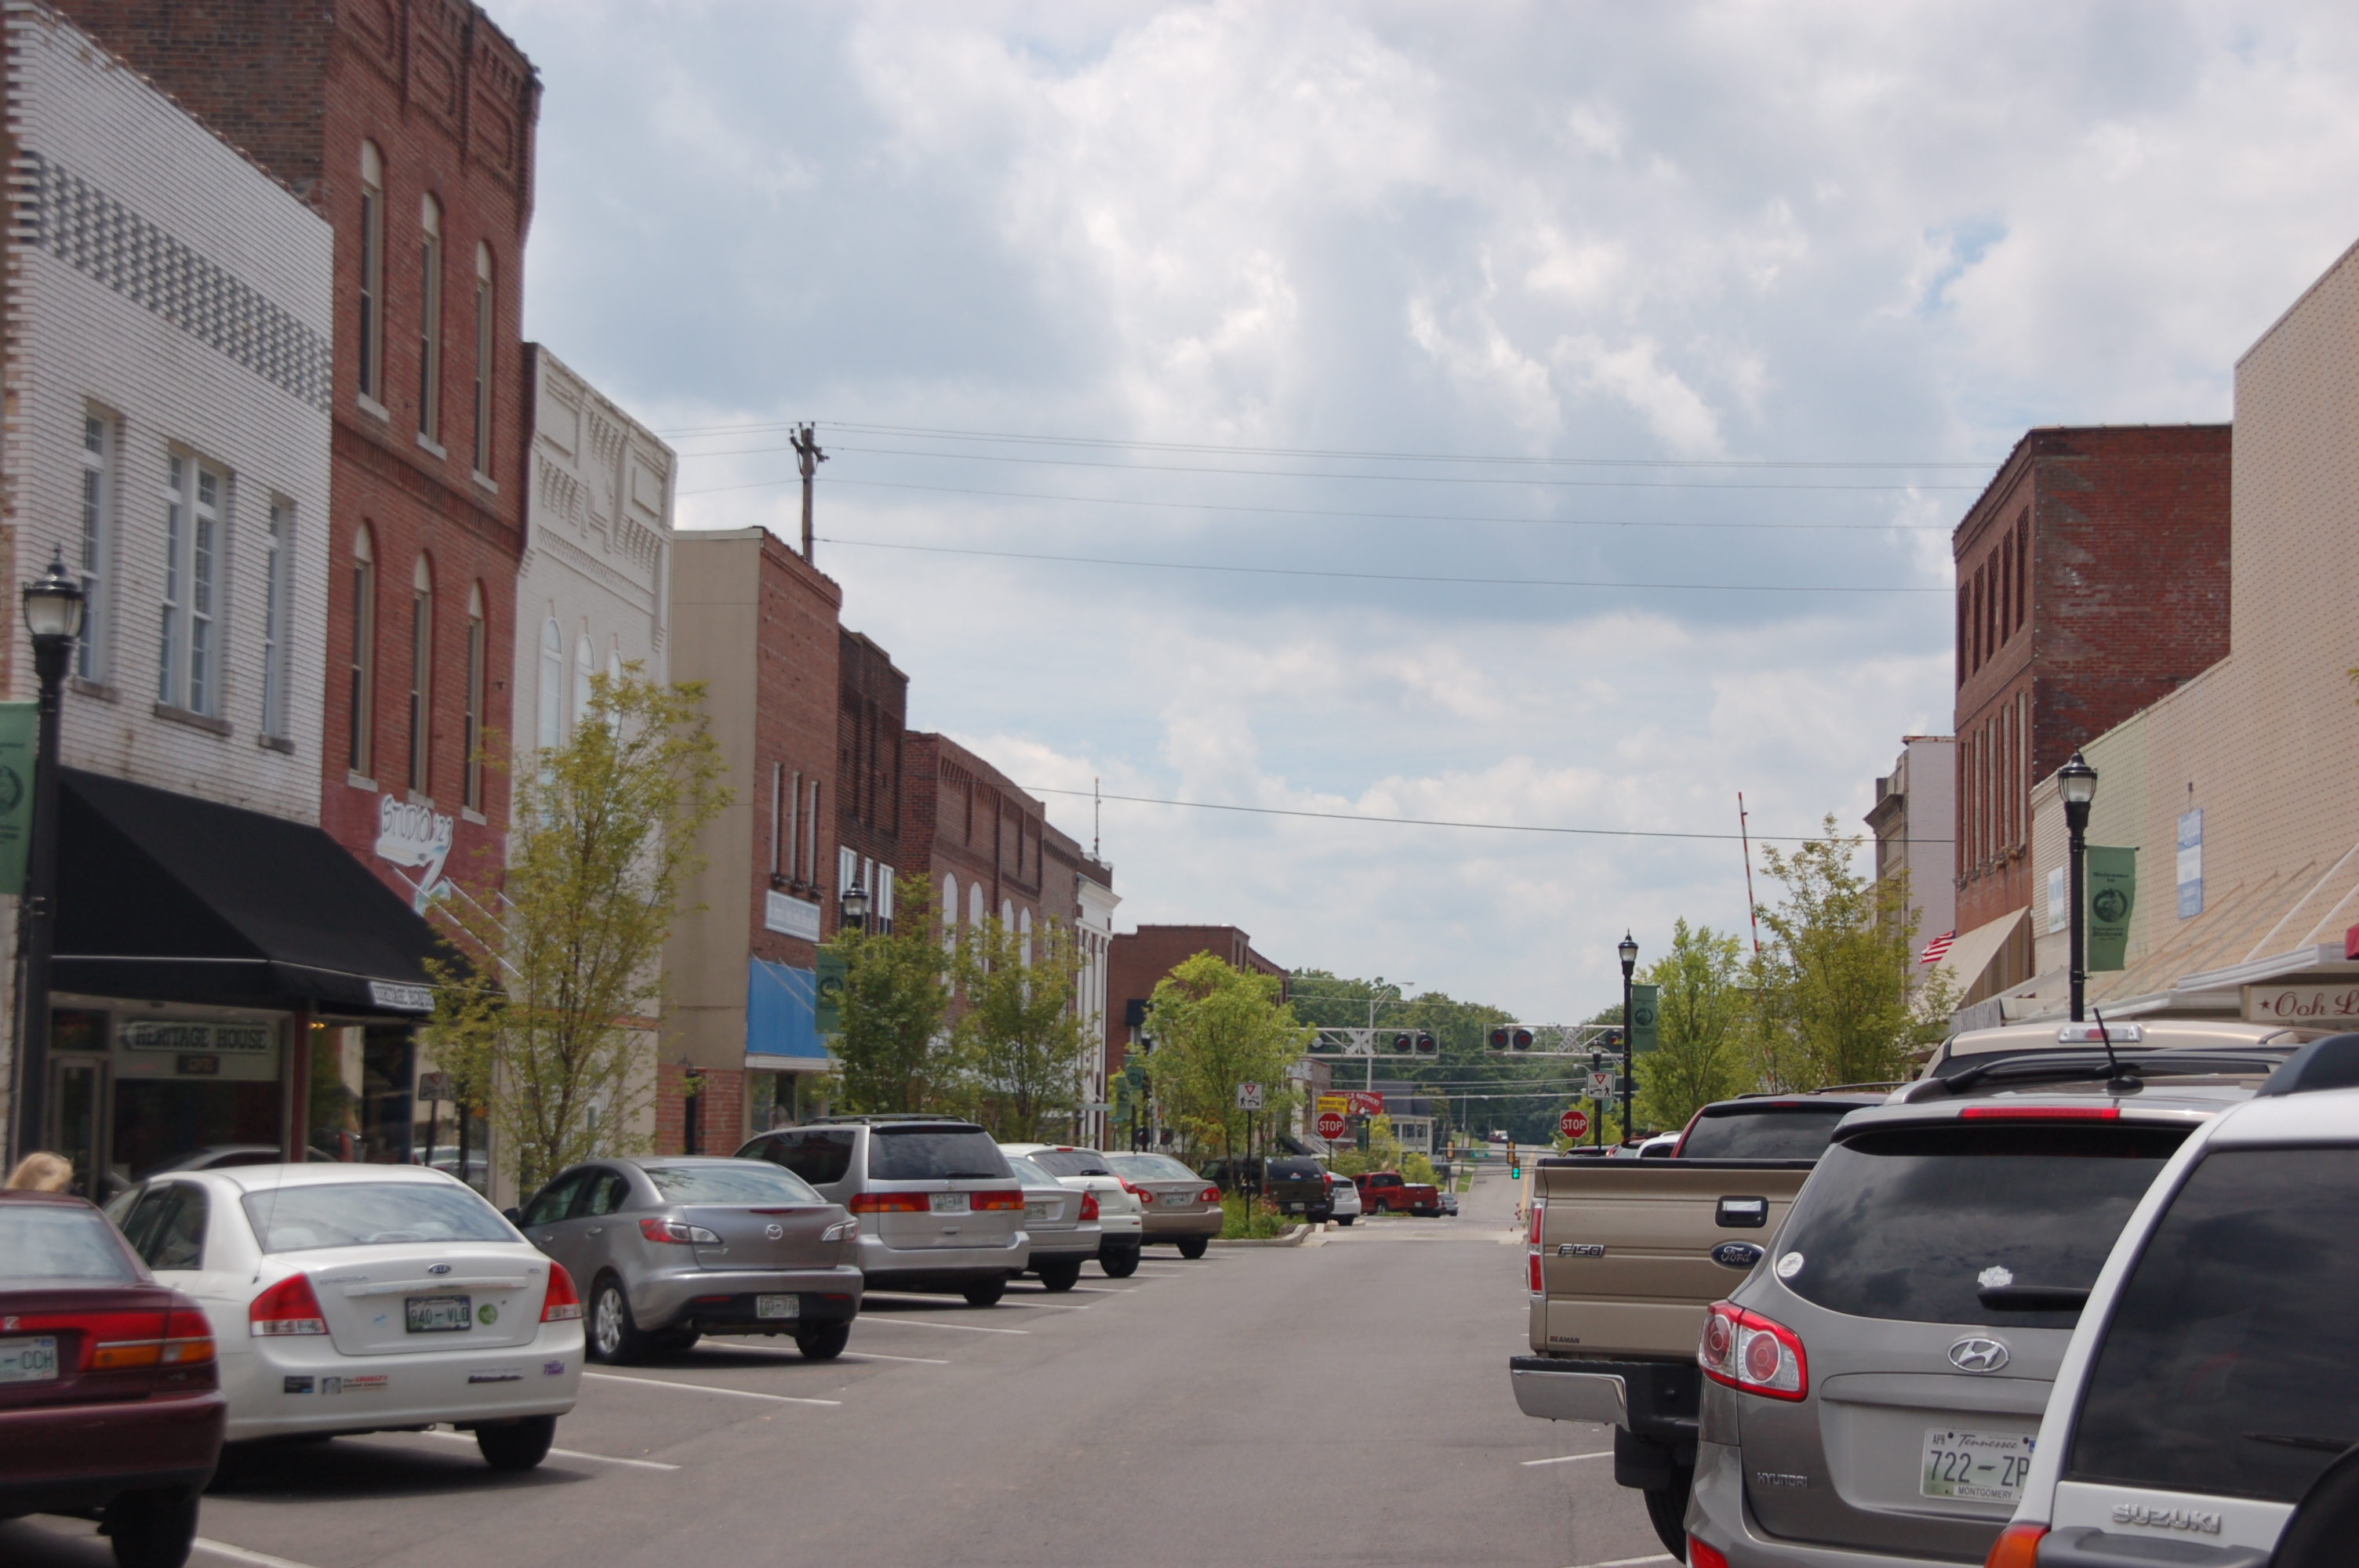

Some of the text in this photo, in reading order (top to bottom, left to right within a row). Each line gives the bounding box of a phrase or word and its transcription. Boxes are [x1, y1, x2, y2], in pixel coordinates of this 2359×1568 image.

[383, 798, 453, 850] STUDIO 123
[2275, 989, 2359, 1017] Ooh L
[135, 1025, 267, 1050] HERITAGE HOUSE
[1319, 1120, 1343, 1131] STOP
[1562, 1119, 1587, 1130] STOP
[1721, 1246, 1752, 1263] Ford
[431, 1264, 451, 1274] KIA
[1550, 1335, 1580, 1344] BEAMAN
[1932, 1434, 2018, 1449] APR Tennessee
[1930, 1450, 2030, 1487] 722-ZP
[1757, 1472, 1808, 1488] HYUNDAI
[1957, 1486, 2012, 1499] MONTGOMERY
[2111, 1504, 2221, 1534] SUZUKI
